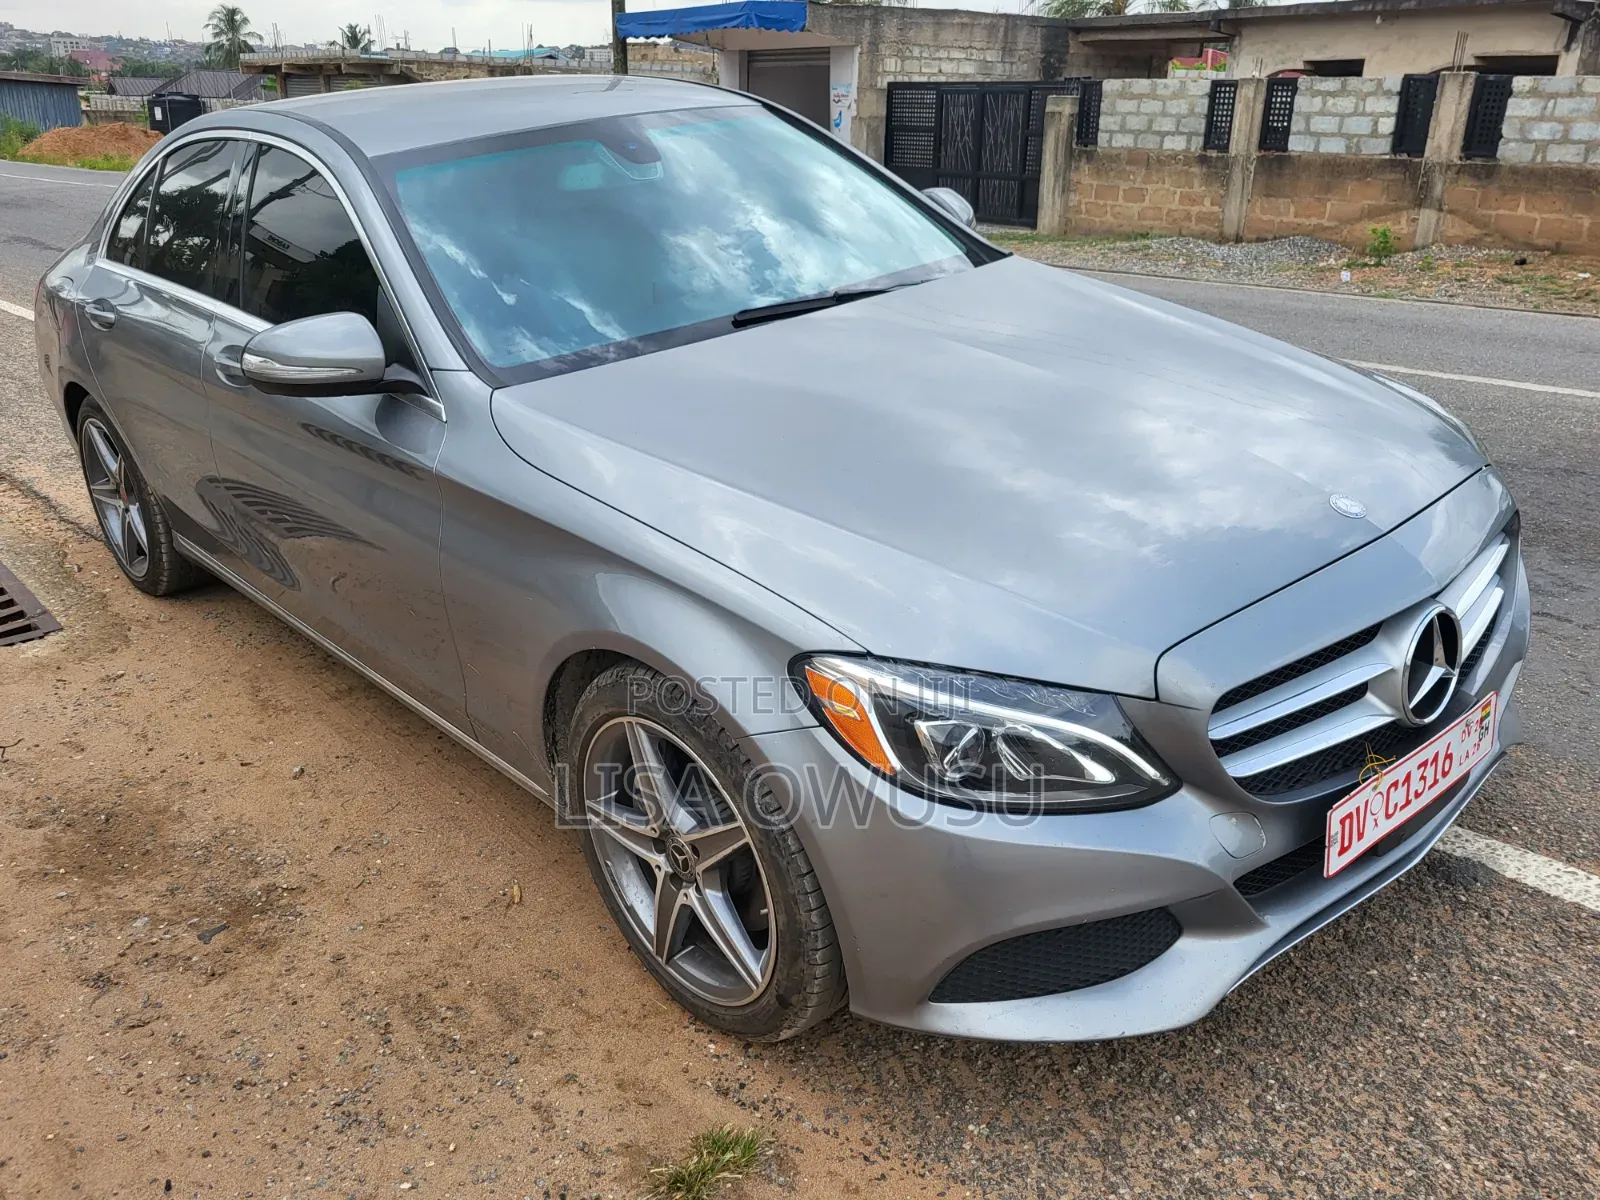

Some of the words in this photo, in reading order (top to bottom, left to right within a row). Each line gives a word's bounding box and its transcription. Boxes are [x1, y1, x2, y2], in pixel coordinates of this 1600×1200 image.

[1478, 720, 1490, 742] GH
[1337, 799, 1369, 857] DV
[1384, 741, 1454, 820] C1316
